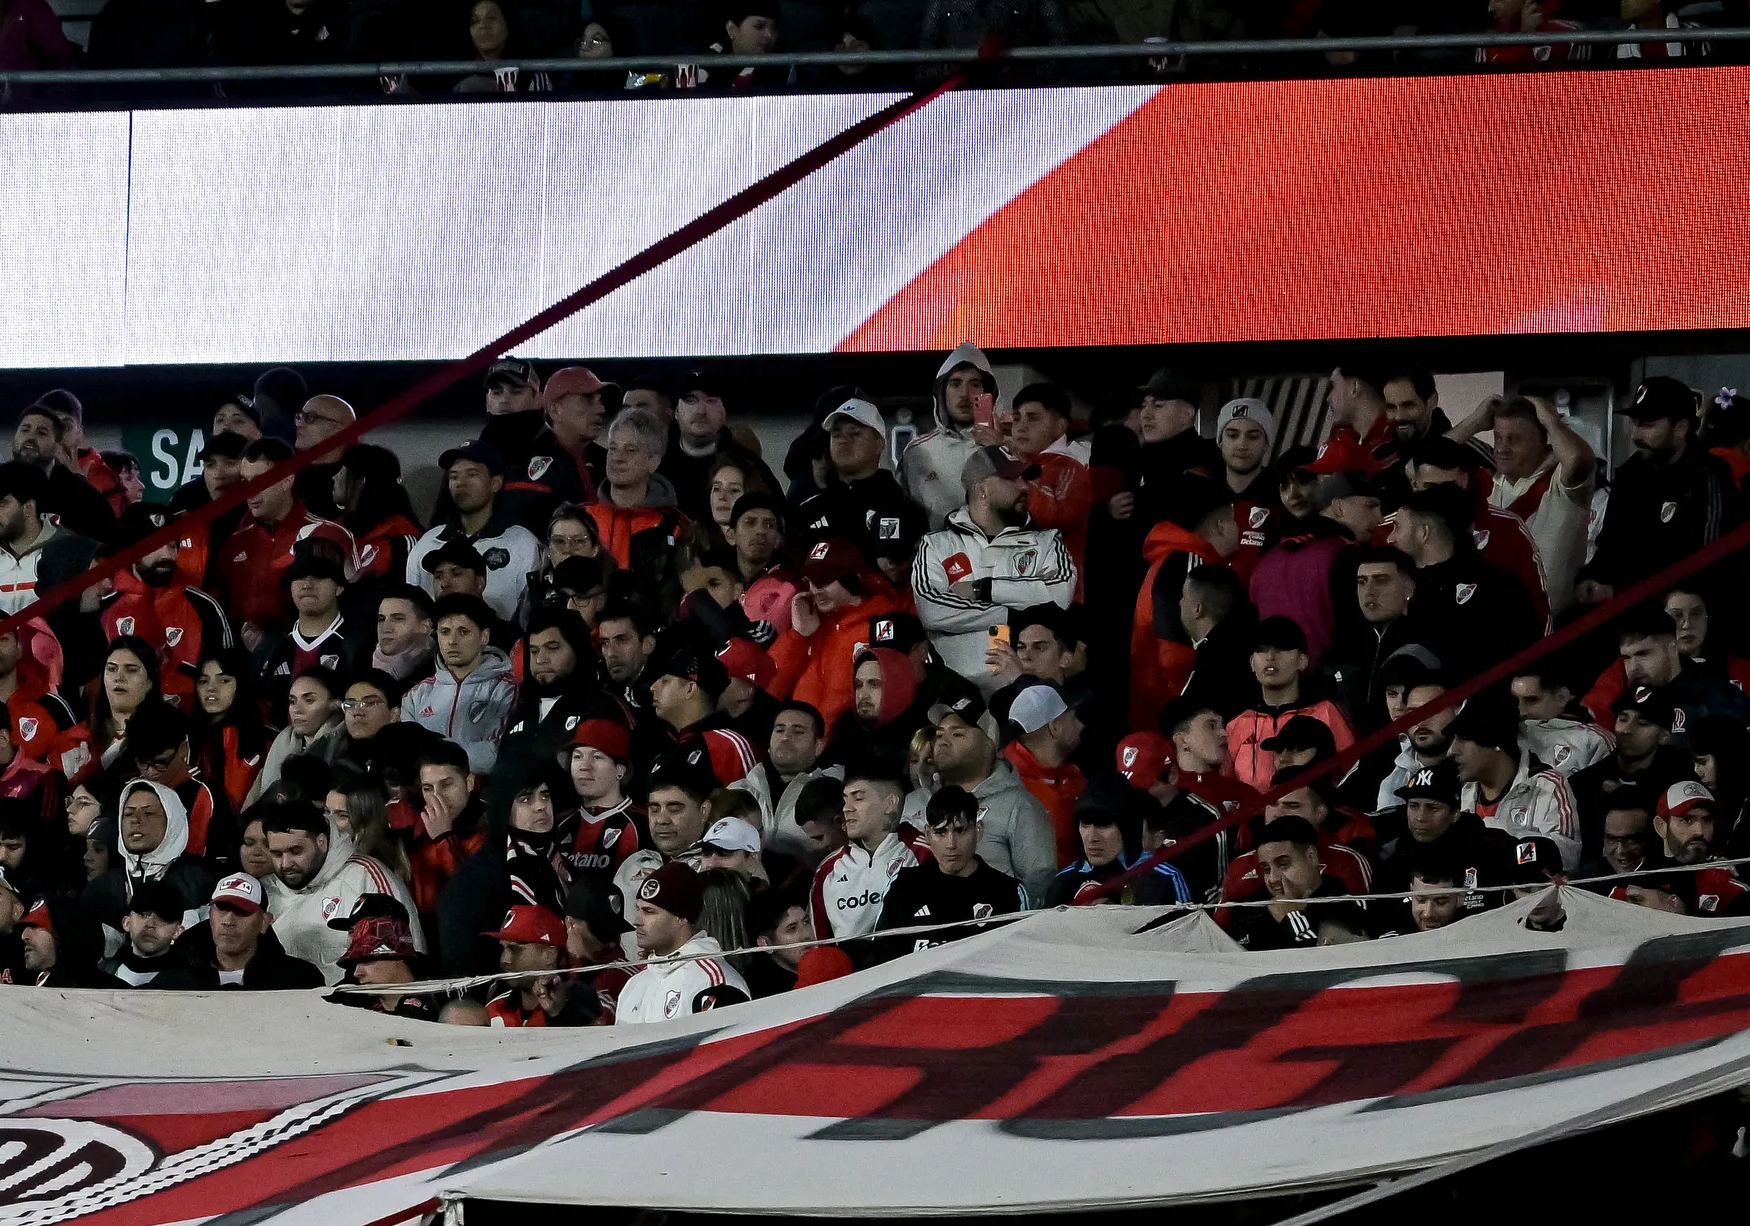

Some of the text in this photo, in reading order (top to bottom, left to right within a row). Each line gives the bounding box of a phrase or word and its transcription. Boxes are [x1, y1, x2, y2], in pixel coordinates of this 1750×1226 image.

[877, 622, 891, 638] 14
[1416, 770, 1433, 786] NY
[561, 852, 611, 869] tano
